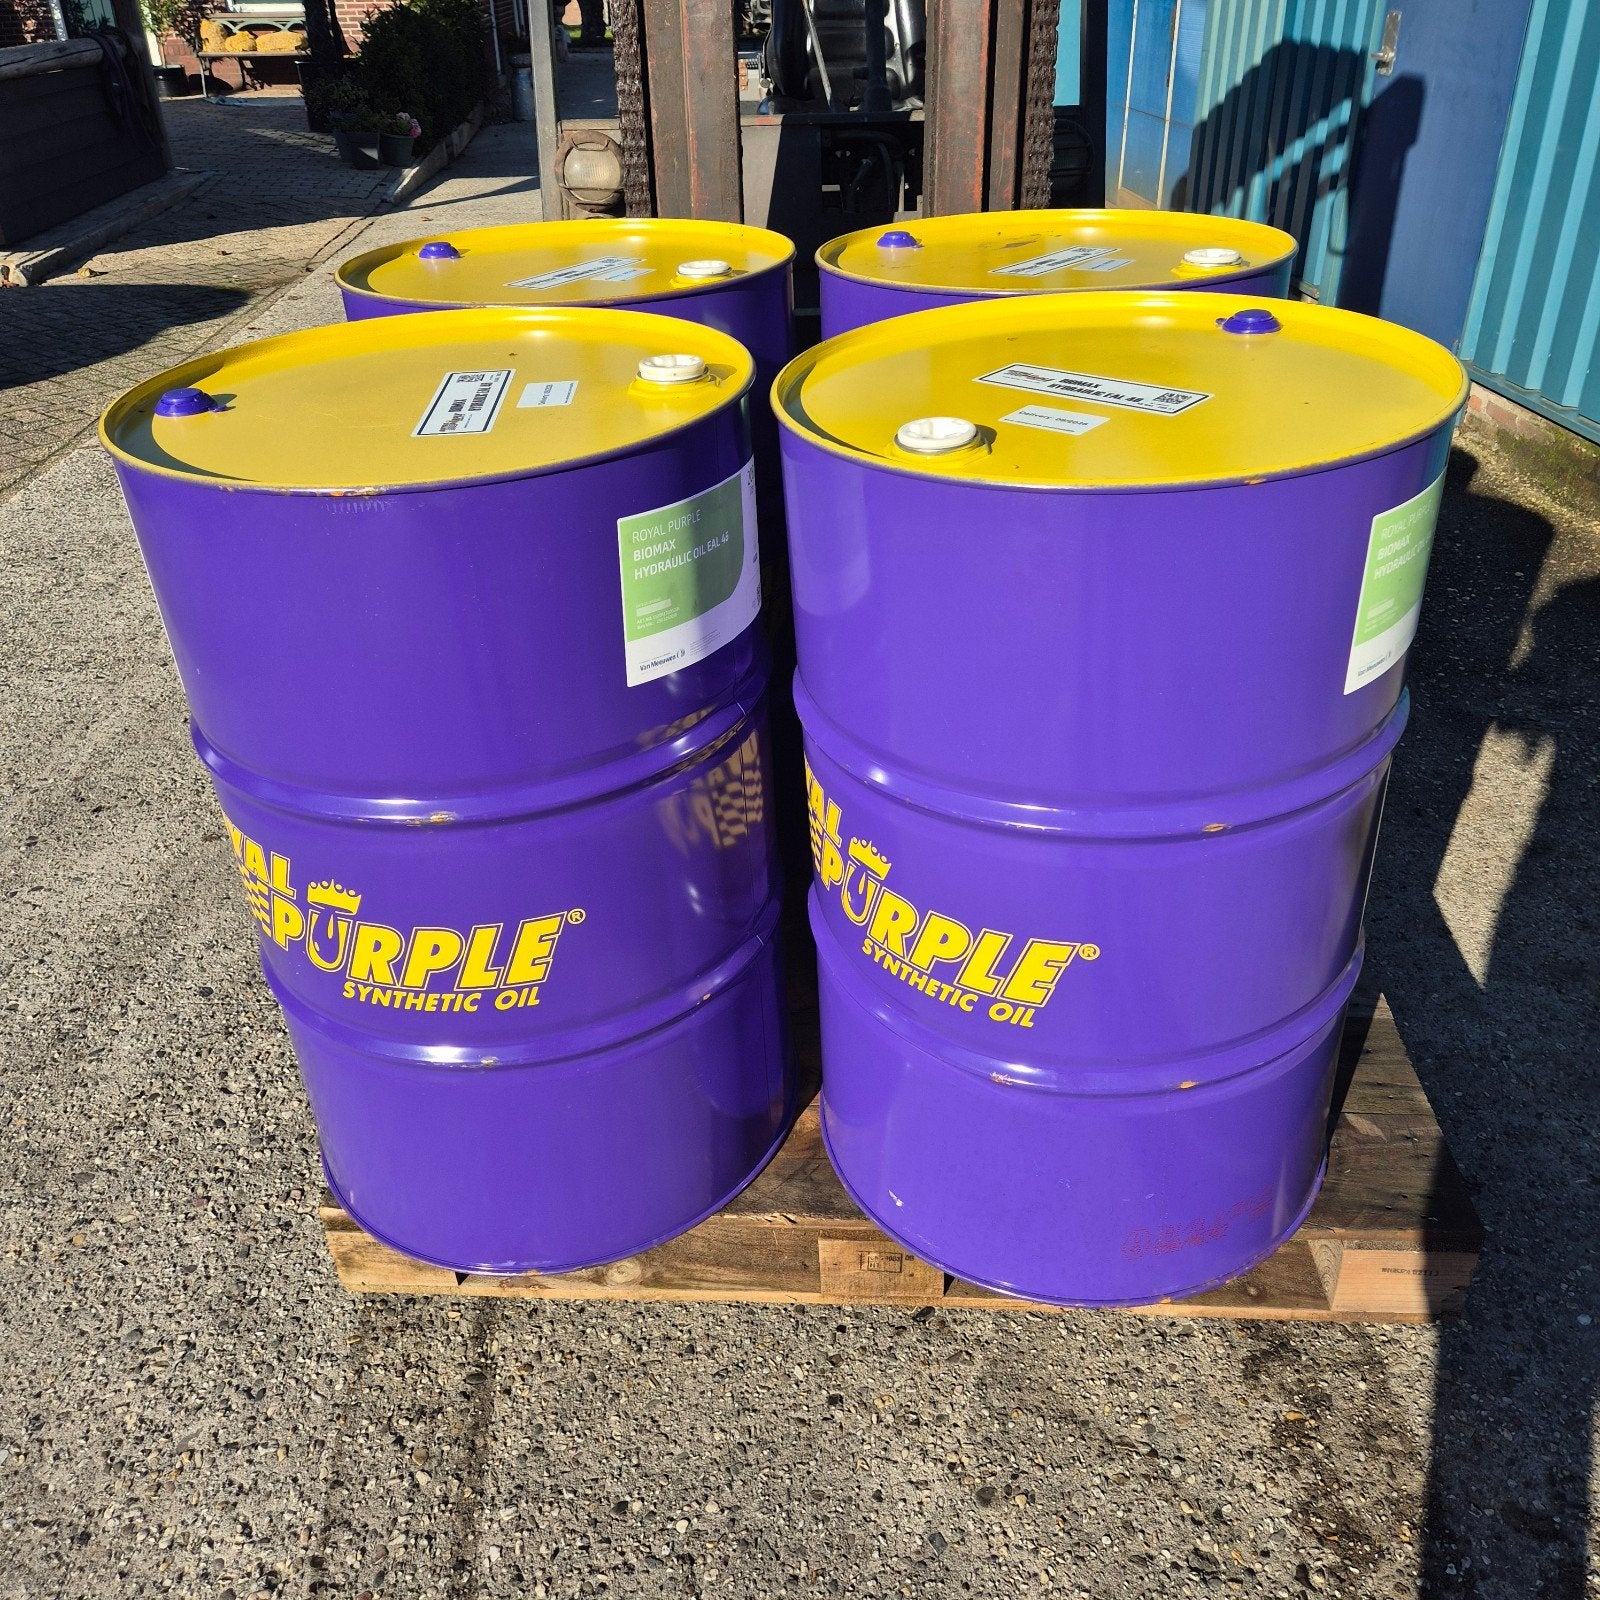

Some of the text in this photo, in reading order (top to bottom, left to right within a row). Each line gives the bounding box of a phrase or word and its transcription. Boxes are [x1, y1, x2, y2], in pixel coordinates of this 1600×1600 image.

[632, 509, 702, 543] ROYAL PURPLE
[633, 538, 676, 561] BIOMAX
[634, 550, 692, 580] HYDRAULIC
[693, 544, 706, 559] OIL
[707, 536, 721, 552] EAL
[342, 981, 541, 1012] SYNTHETIC OIL
[861, 938, 1035, 1028] SYNTHETIC OIL
